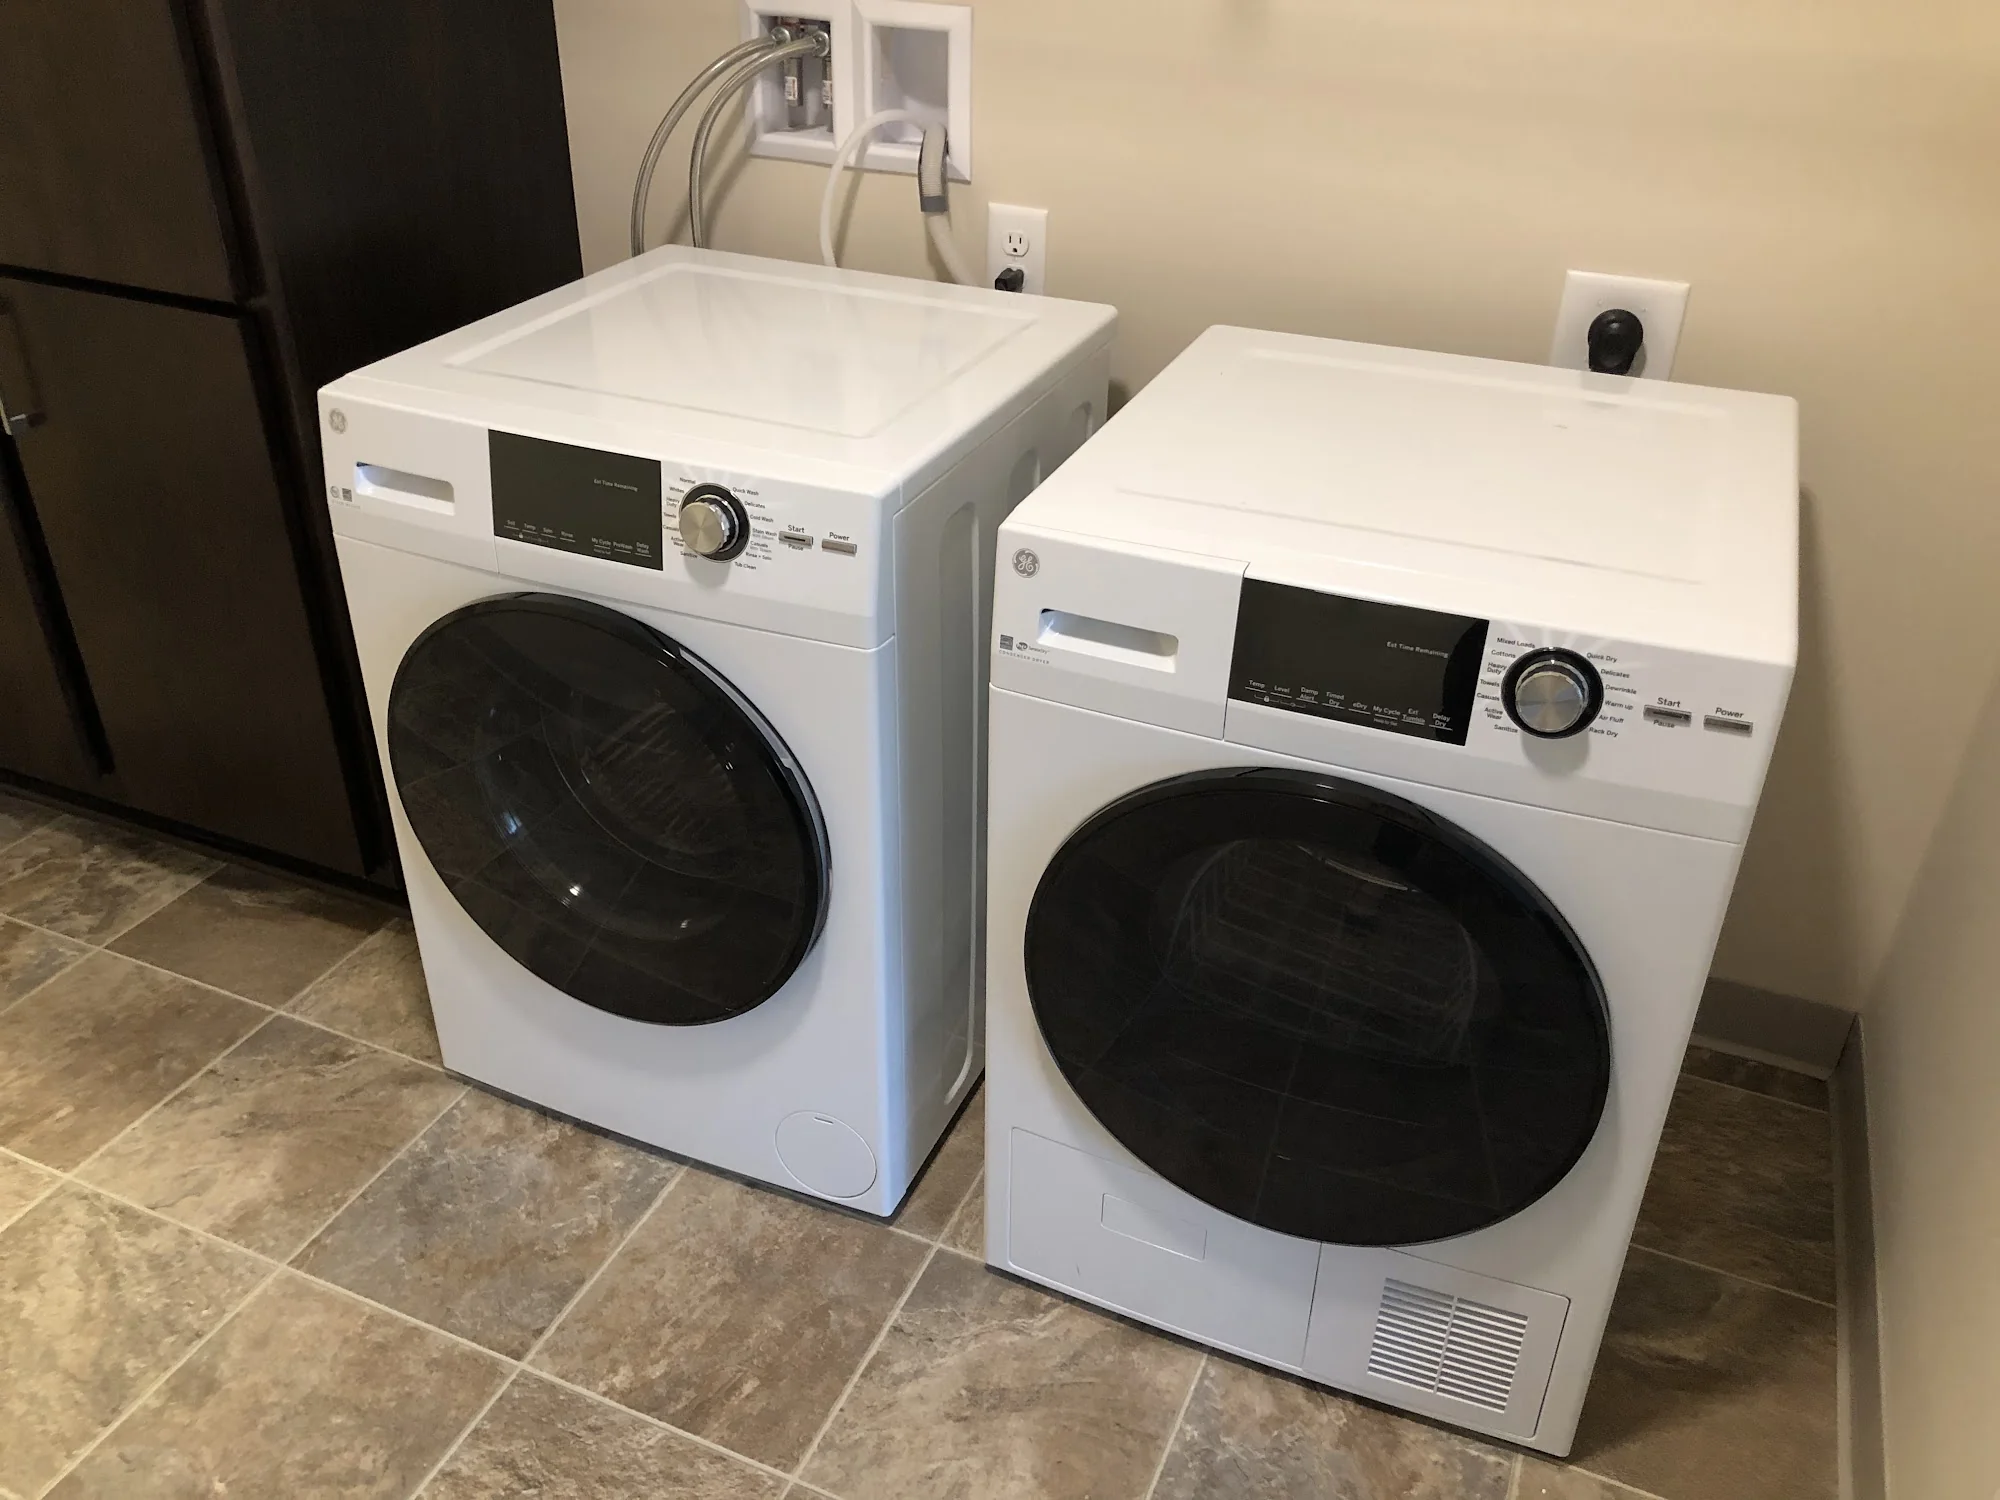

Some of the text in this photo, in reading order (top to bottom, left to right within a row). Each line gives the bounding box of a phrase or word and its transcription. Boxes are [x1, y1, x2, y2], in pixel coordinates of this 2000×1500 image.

[744, 500, 766, 509] Delicates
[787, 524, 805, 533] Start
[829, 531, 850, 541] Power
[788, 543, 804, 551] Pause
[1399, 643, 1414, 652] Time
[1496, 637, 1536, 649] Mixed Loads
[1491, 649, 1516, 659] Cottons
[1586, 652, 1618, 664] Quick Dry
[1486, 667, 1502, 675] Duty
[1487, 662, 1507, 671] Heavy
[1600, 668, 1630, 679] Delicates
[1249, 679, 1266, 689] Temp
[1480, 678, 1500, 688] Towels
[1274, 684, 1290, 693] Level
[1300, 686, 1319, 696] Damp
[1605, 684, 1637, 695] Dewrinkle
[1476, 692, 1500, 702] Casuals
[1328, 698, 1340, 707] Dry
[1604, 700, 1624, 708] Warm
[1657, 697, 1681, 708] Start
[1372, 705, 1401, 716] My Cycle
[1715, 707, 1745, 719] Power
[1432, 712, 1451, 723] Delay
[1434, 719, 1447, 728] Dry
[1493, 723, 1519, 734] Sanitize
[1653, 719, 1675, 729] Pause
[1588, 726, 1619, 738] Rack Dry
